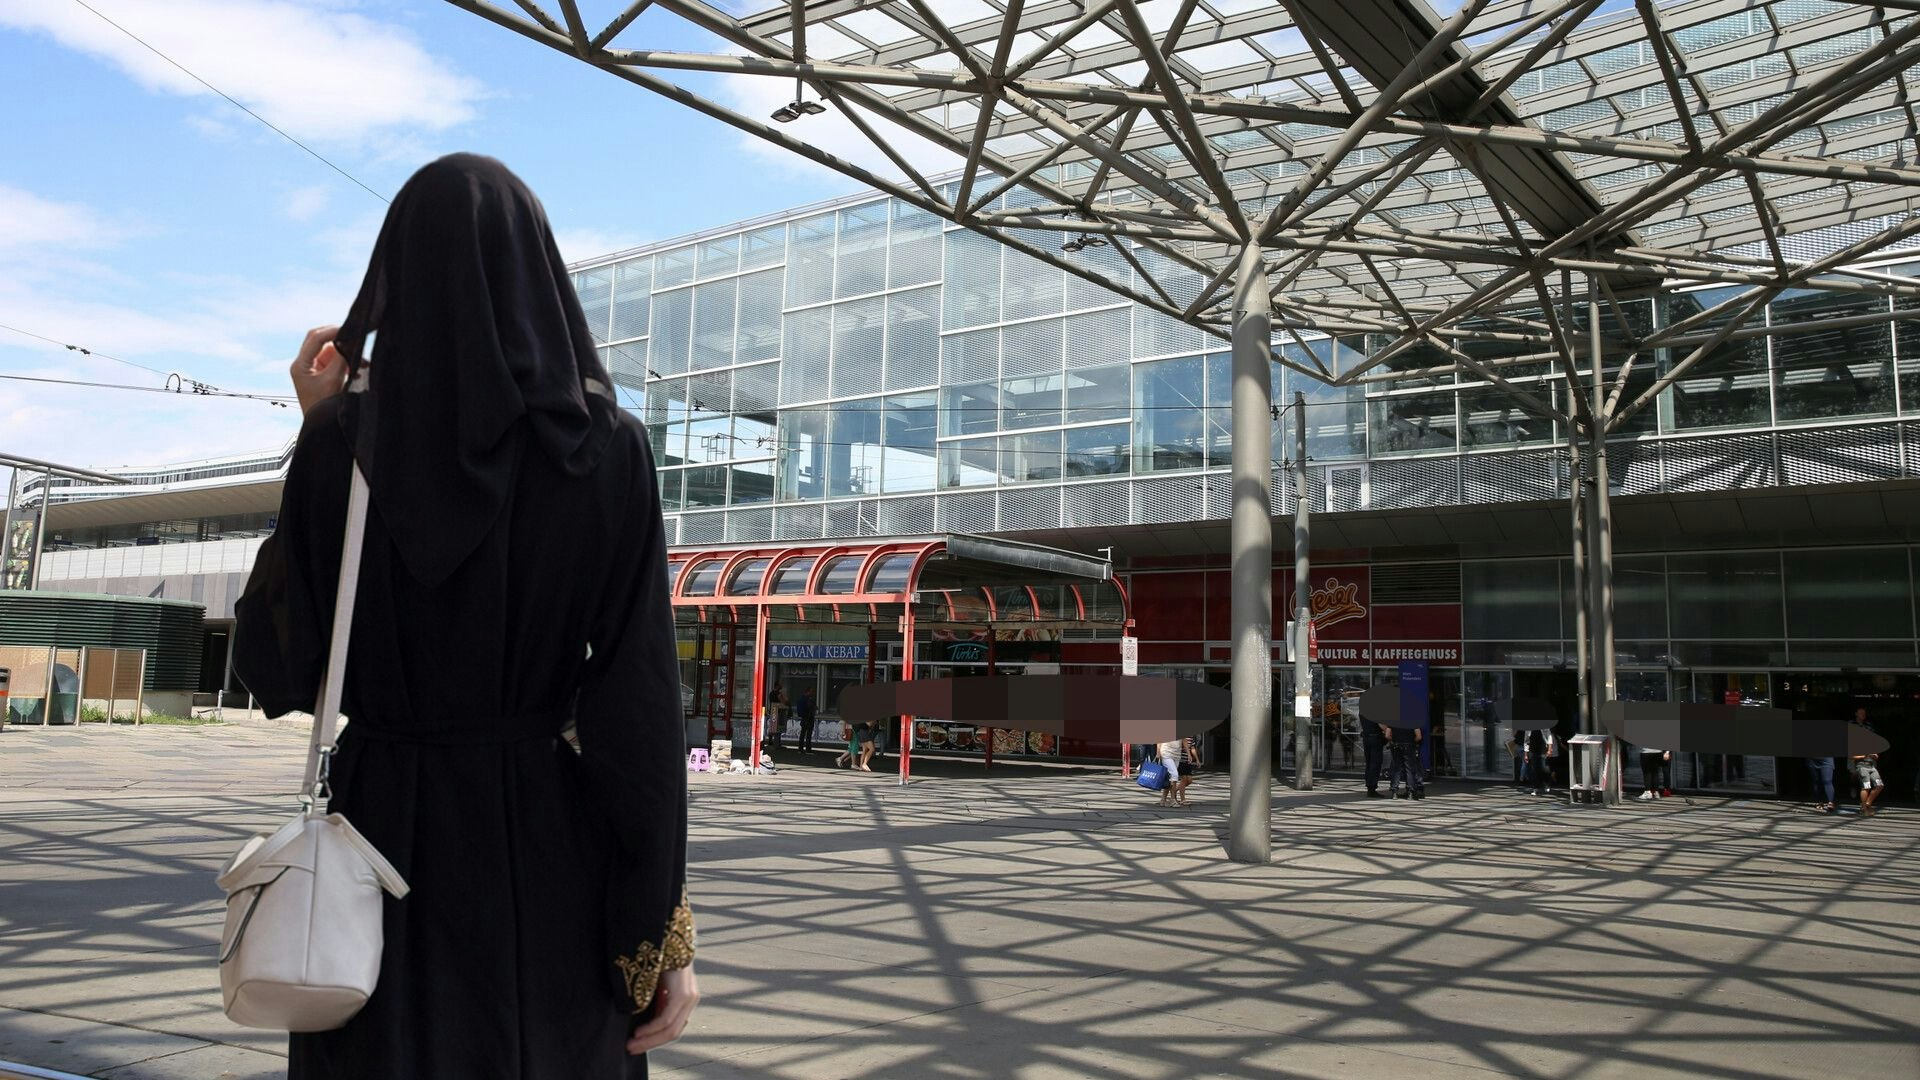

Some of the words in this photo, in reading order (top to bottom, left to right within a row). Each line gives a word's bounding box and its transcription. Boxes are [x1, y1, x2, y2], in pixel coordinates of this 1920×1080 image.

[781, 645, 814, 658] CIVAN
[825, 645, 861, 658] KEBAP
[1317, 648, 1357, 660] KULTUR
[1361, 648, 1369, 660] &
[1375, 648, 1457, 660] KAFFEEGENUSS
